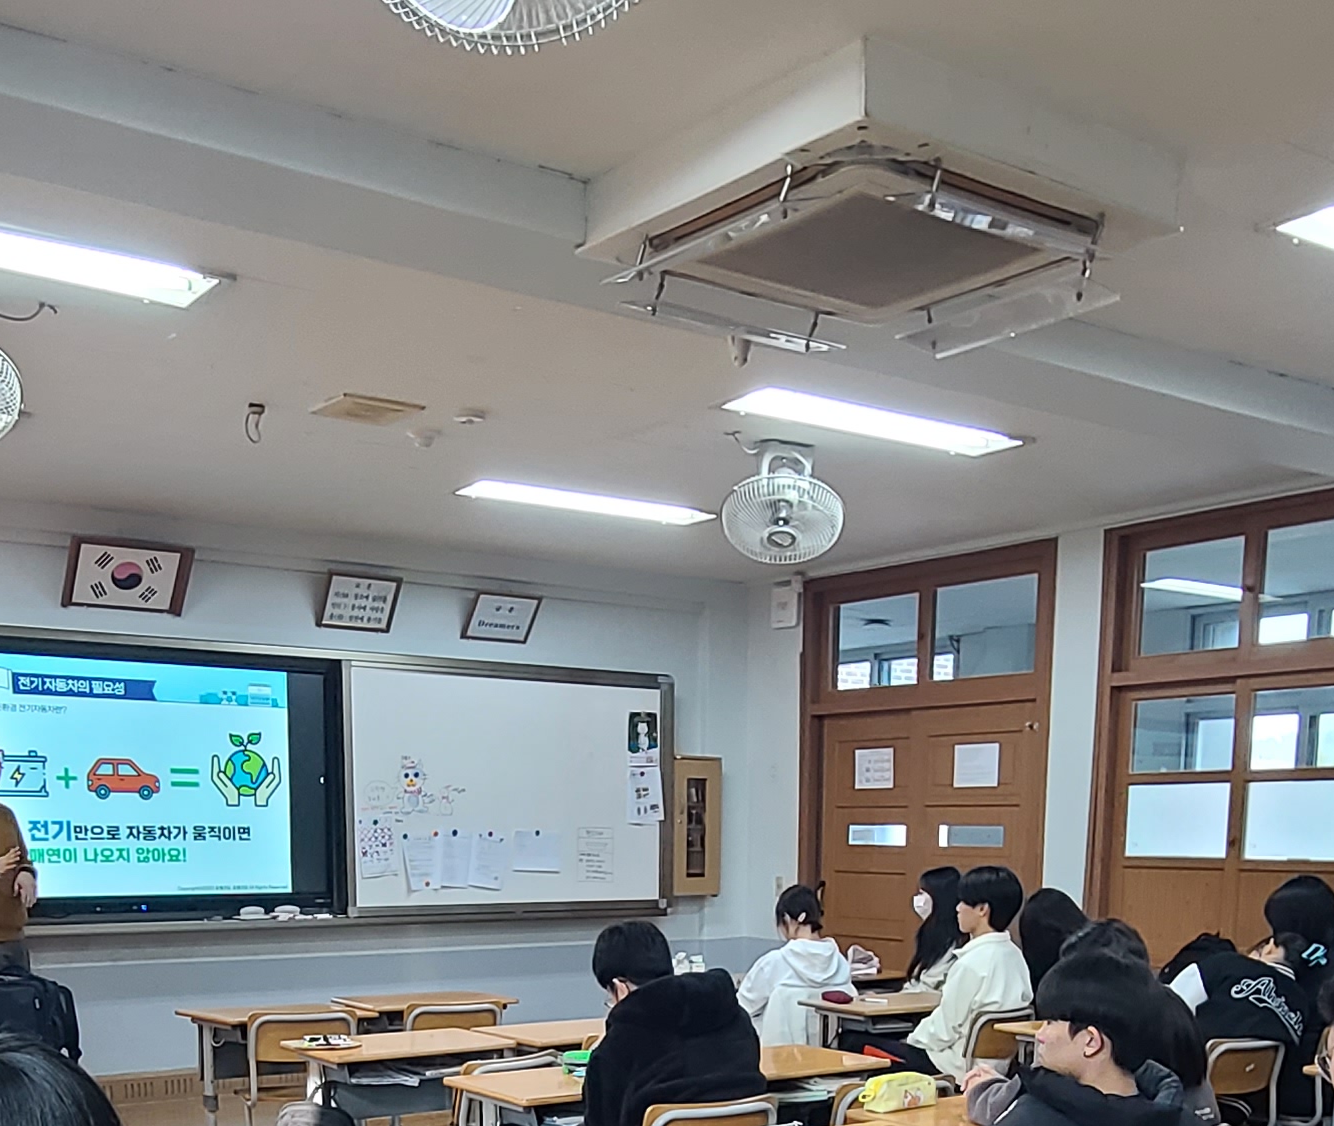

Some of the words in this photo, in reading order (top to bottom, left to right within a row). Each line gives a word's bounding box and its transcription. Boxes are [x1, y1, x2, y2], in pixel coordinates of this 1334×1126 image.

[478, 619, 520, 630] Dreamers
[18, 675, 42, 691] 전기
[44, 677, 90, 693] 자동차의
[91, 680, 125, 695] 필요성
[27, 819, 121, 842] 전기만으로
[125, 825, 188, 842] 자동차가
[192, 825, 252, 842] 움직이면
[29, 847, 78, 864] 매연이
[83, 847, 131, 864] 나오지
[135, 847, 187, 864] 않아요!
